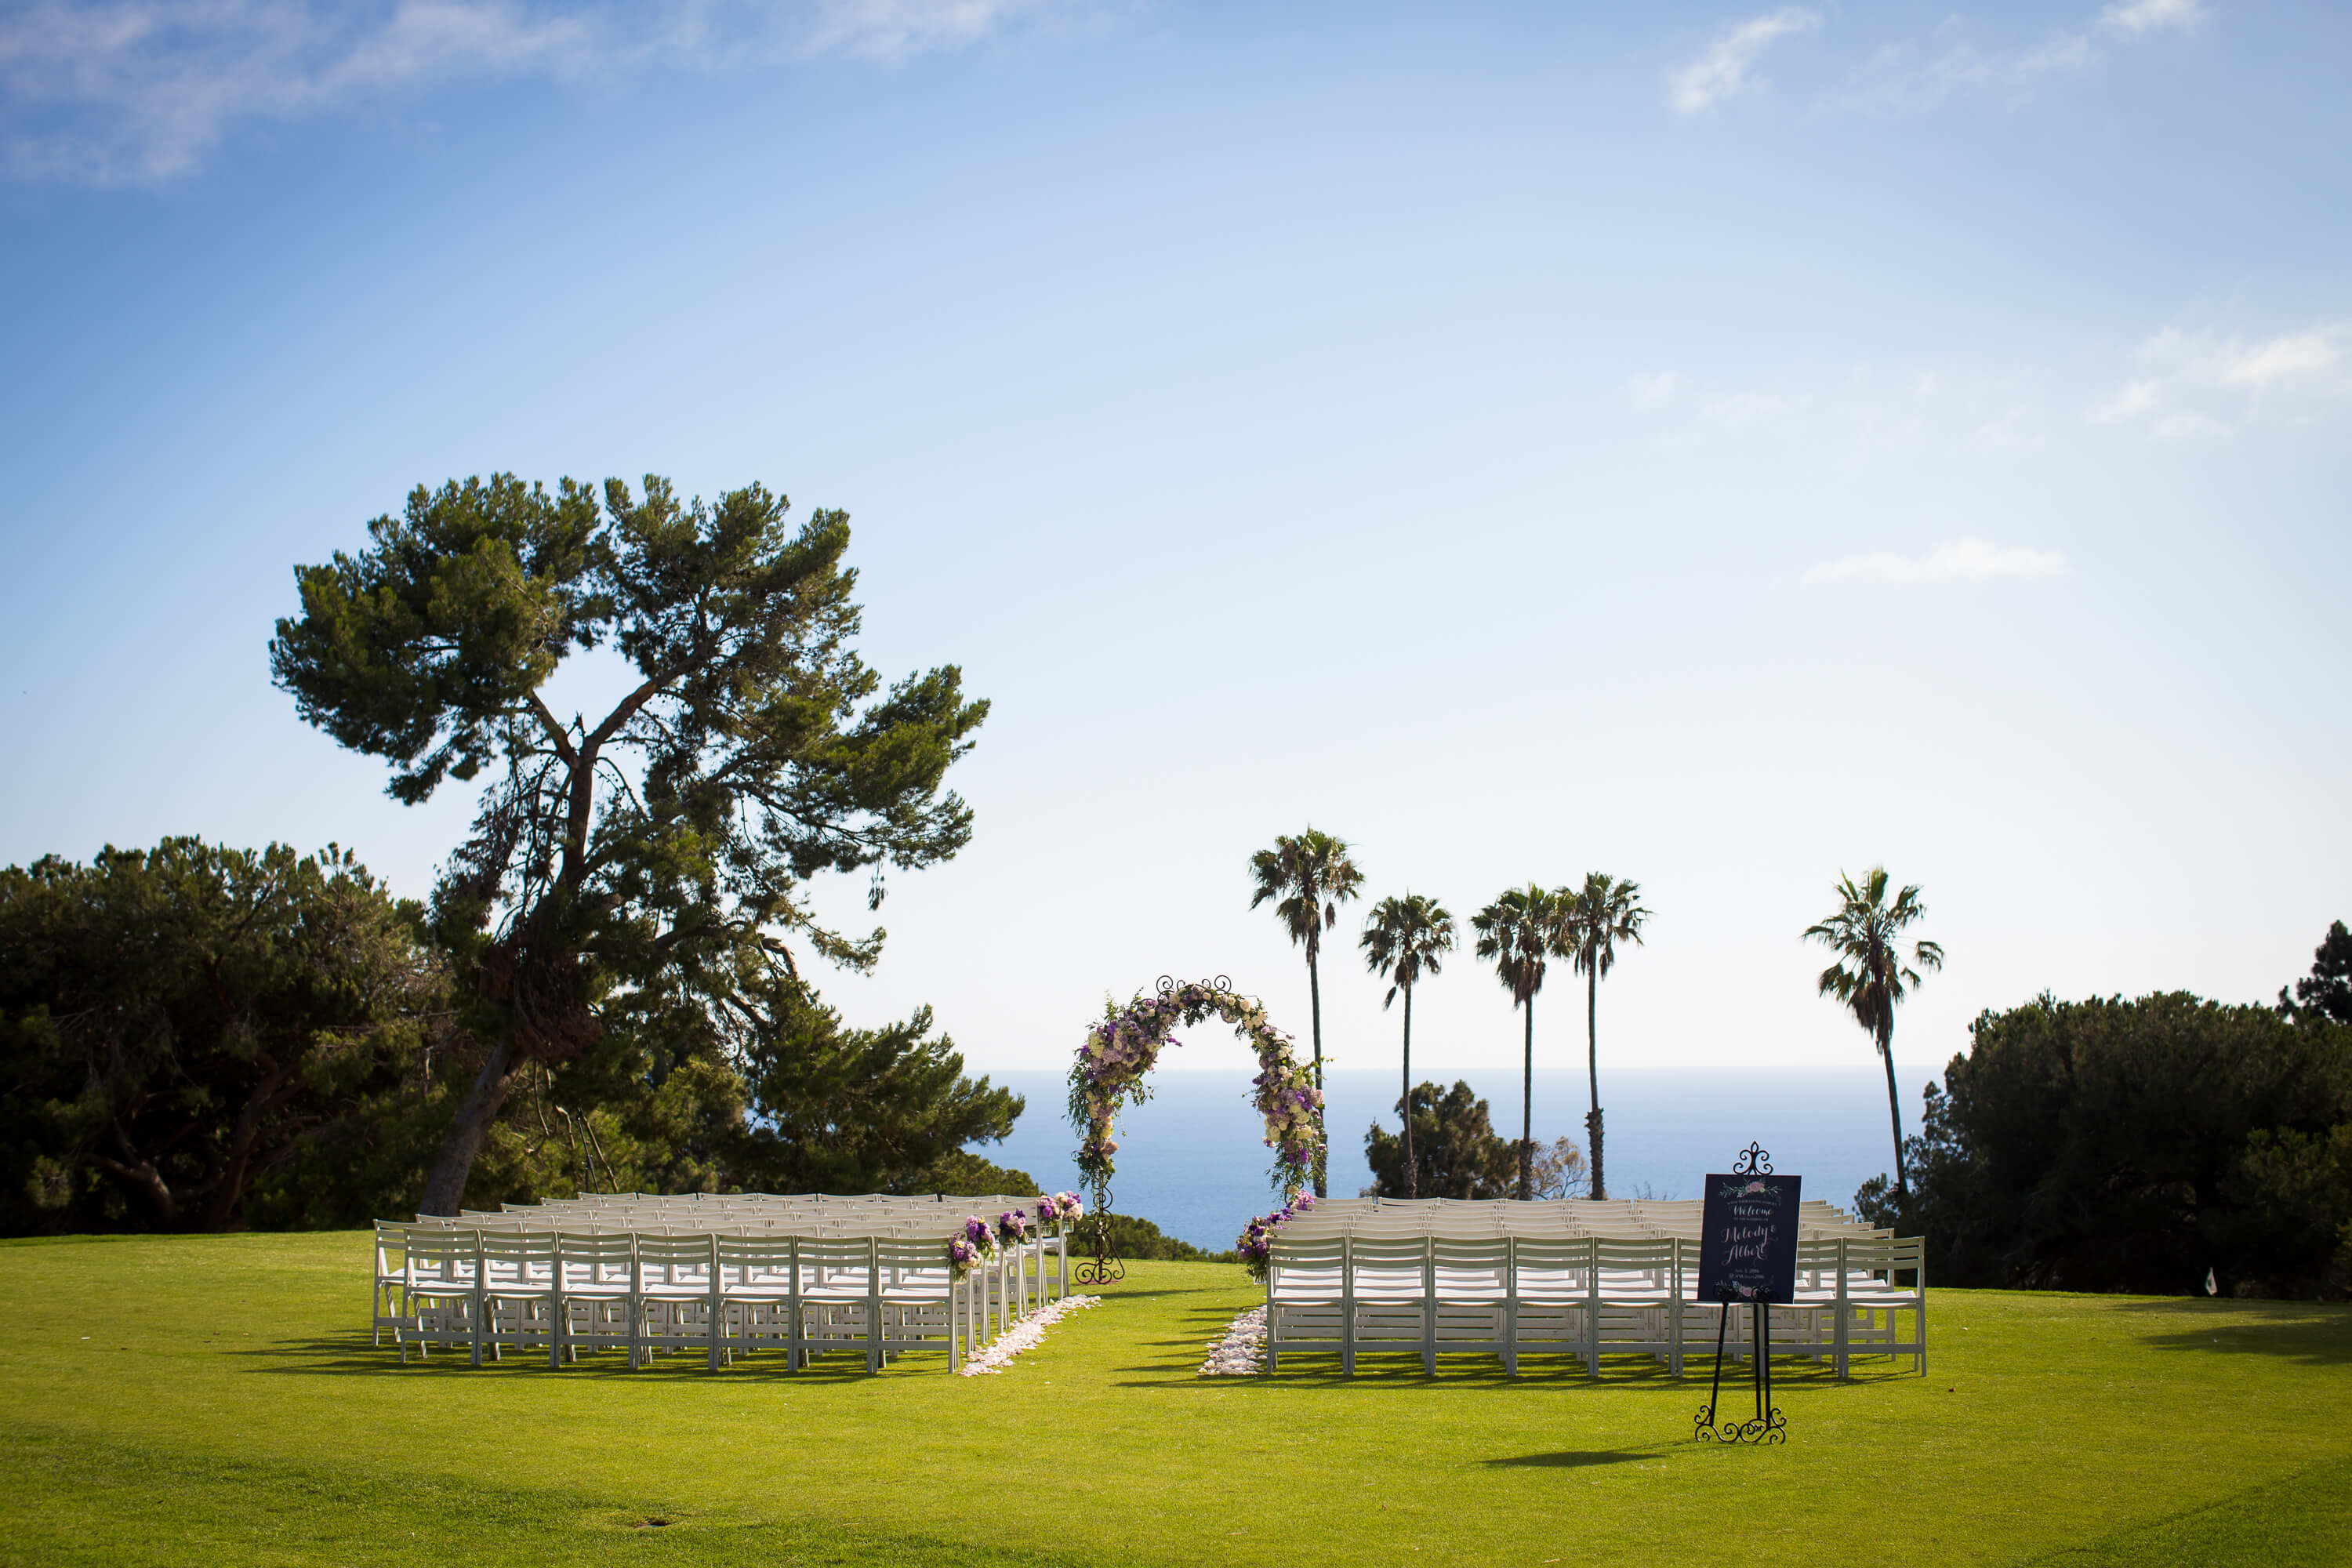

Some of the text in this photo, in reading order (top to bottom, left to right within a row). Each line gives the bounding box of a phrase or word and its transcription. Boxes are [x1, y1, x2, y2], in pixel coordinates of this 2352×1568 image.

[1733, 1205, 1773, 1216] Welcome
[1722, 1225, 1770, 1246] Melody
[1722, 1243, 1768, 1265] Albert
